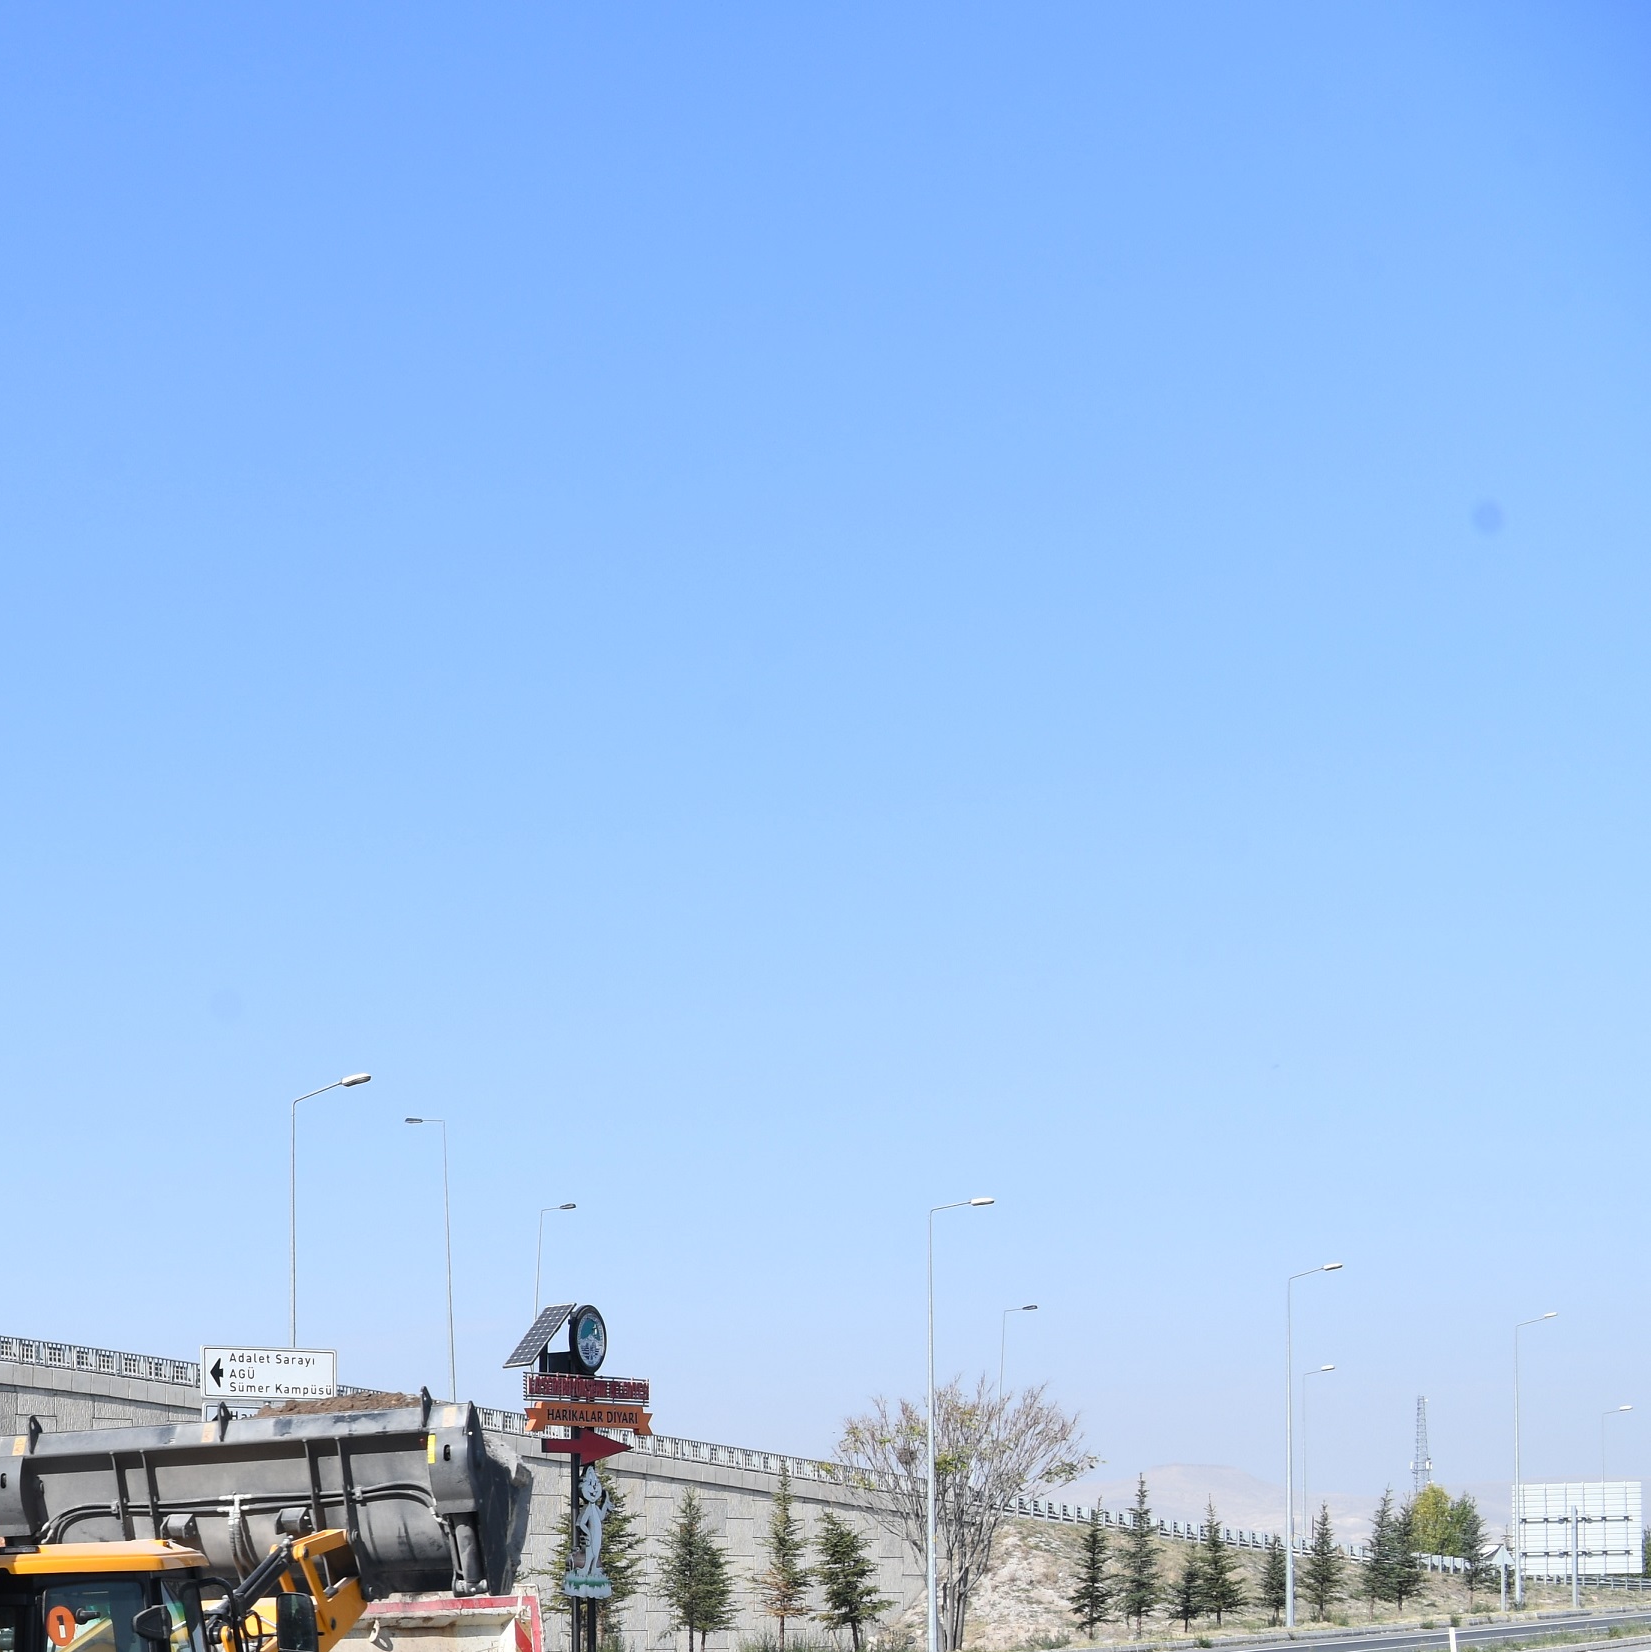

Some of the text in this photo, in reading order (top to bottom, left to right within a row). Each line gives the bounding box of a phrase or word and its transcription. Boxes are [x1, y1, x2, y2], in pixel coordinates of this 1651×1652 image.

[229, 1353, 315, 1367] Adalet Sarayı
[229, 1367, 255, 1379] AGÜ
[229, 1382, 332, 1396] Sümer Kampüsü
[546, 1405, 638, 1424] HARİKALAR DİYARI
